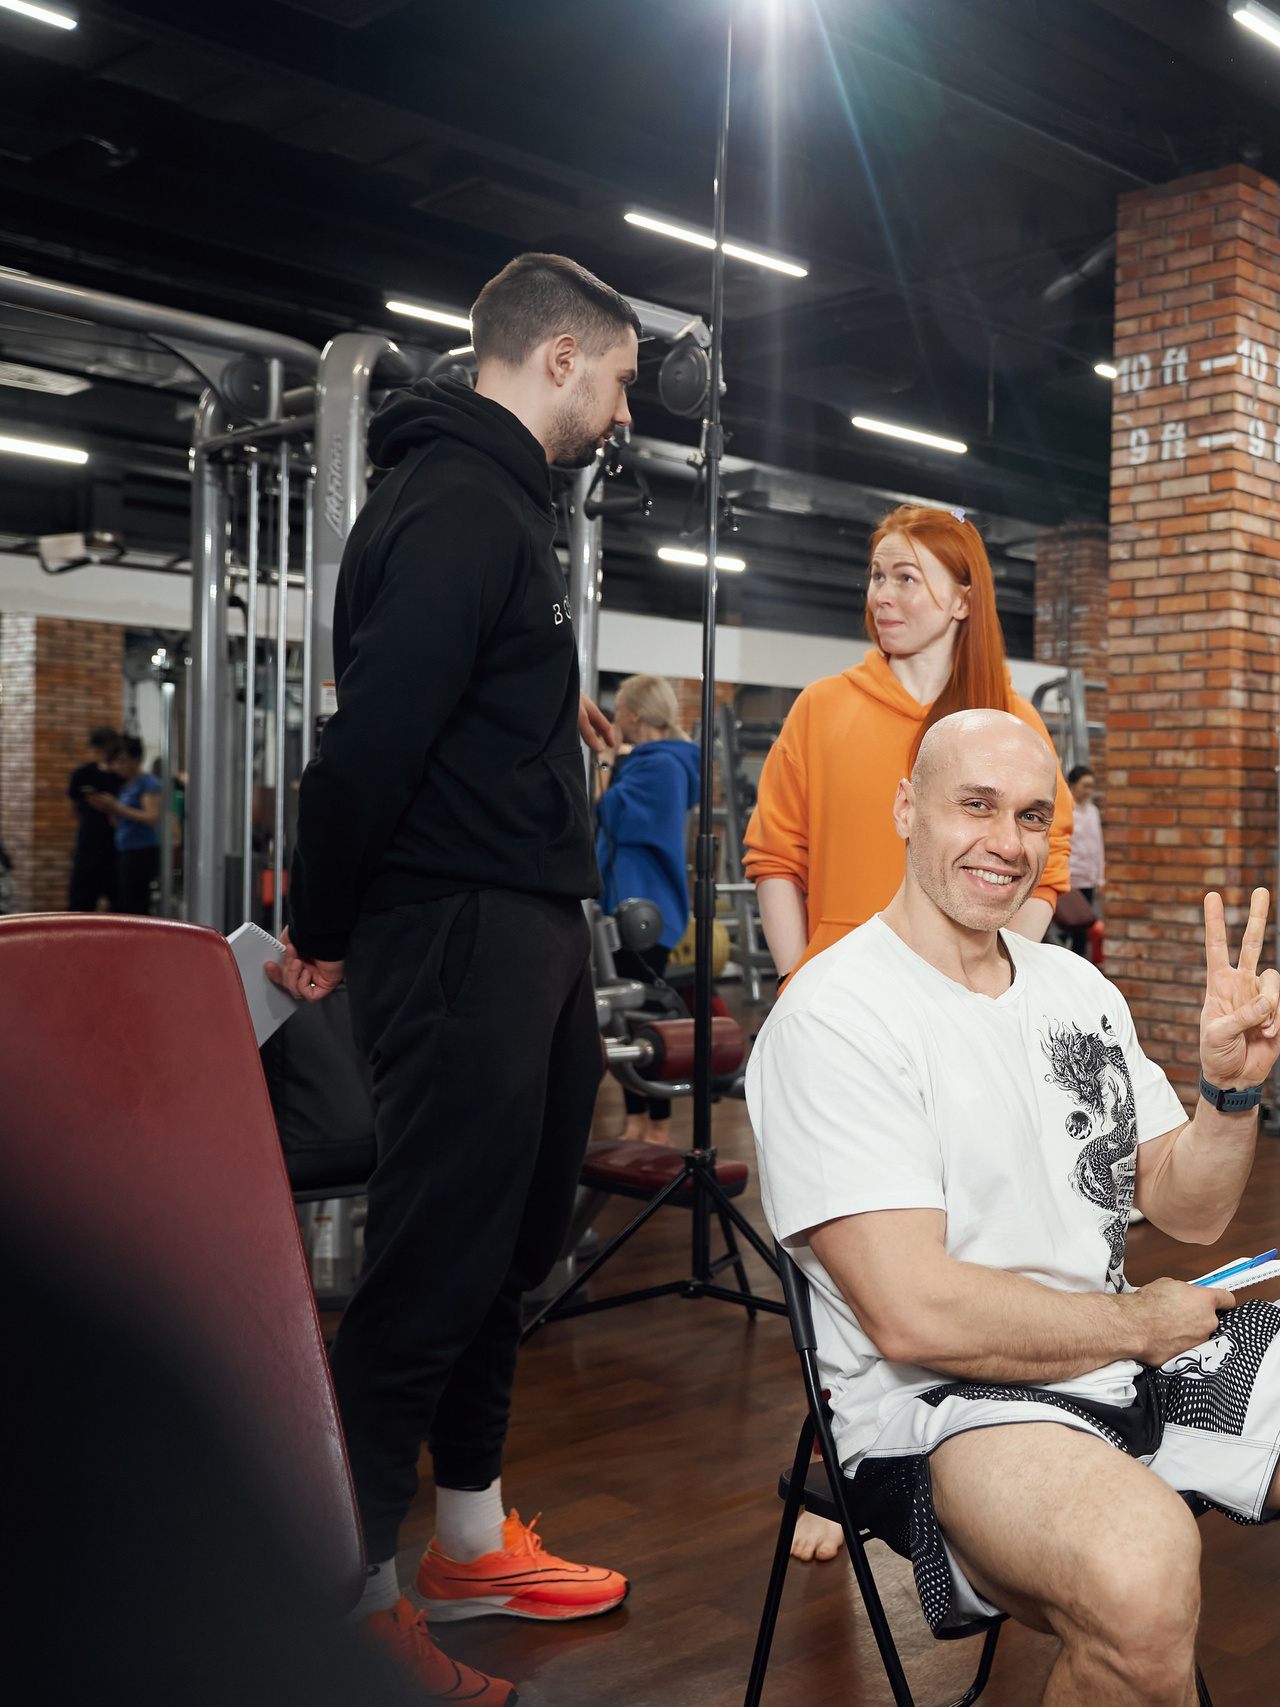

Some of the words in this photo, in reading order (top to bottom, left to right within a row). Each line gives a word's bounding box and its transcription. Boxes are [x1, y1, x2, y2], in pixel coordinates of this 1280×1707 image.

[1117, 353, 1151, 393] 10
[1161, 347, 1188, 385] ft
[1236, 338, 1268, 382] 10
[1129, 427, 1150, 465] 9
[1160, 422, 1187, 461] ft
[1247, 419, 1267, 457] 9
